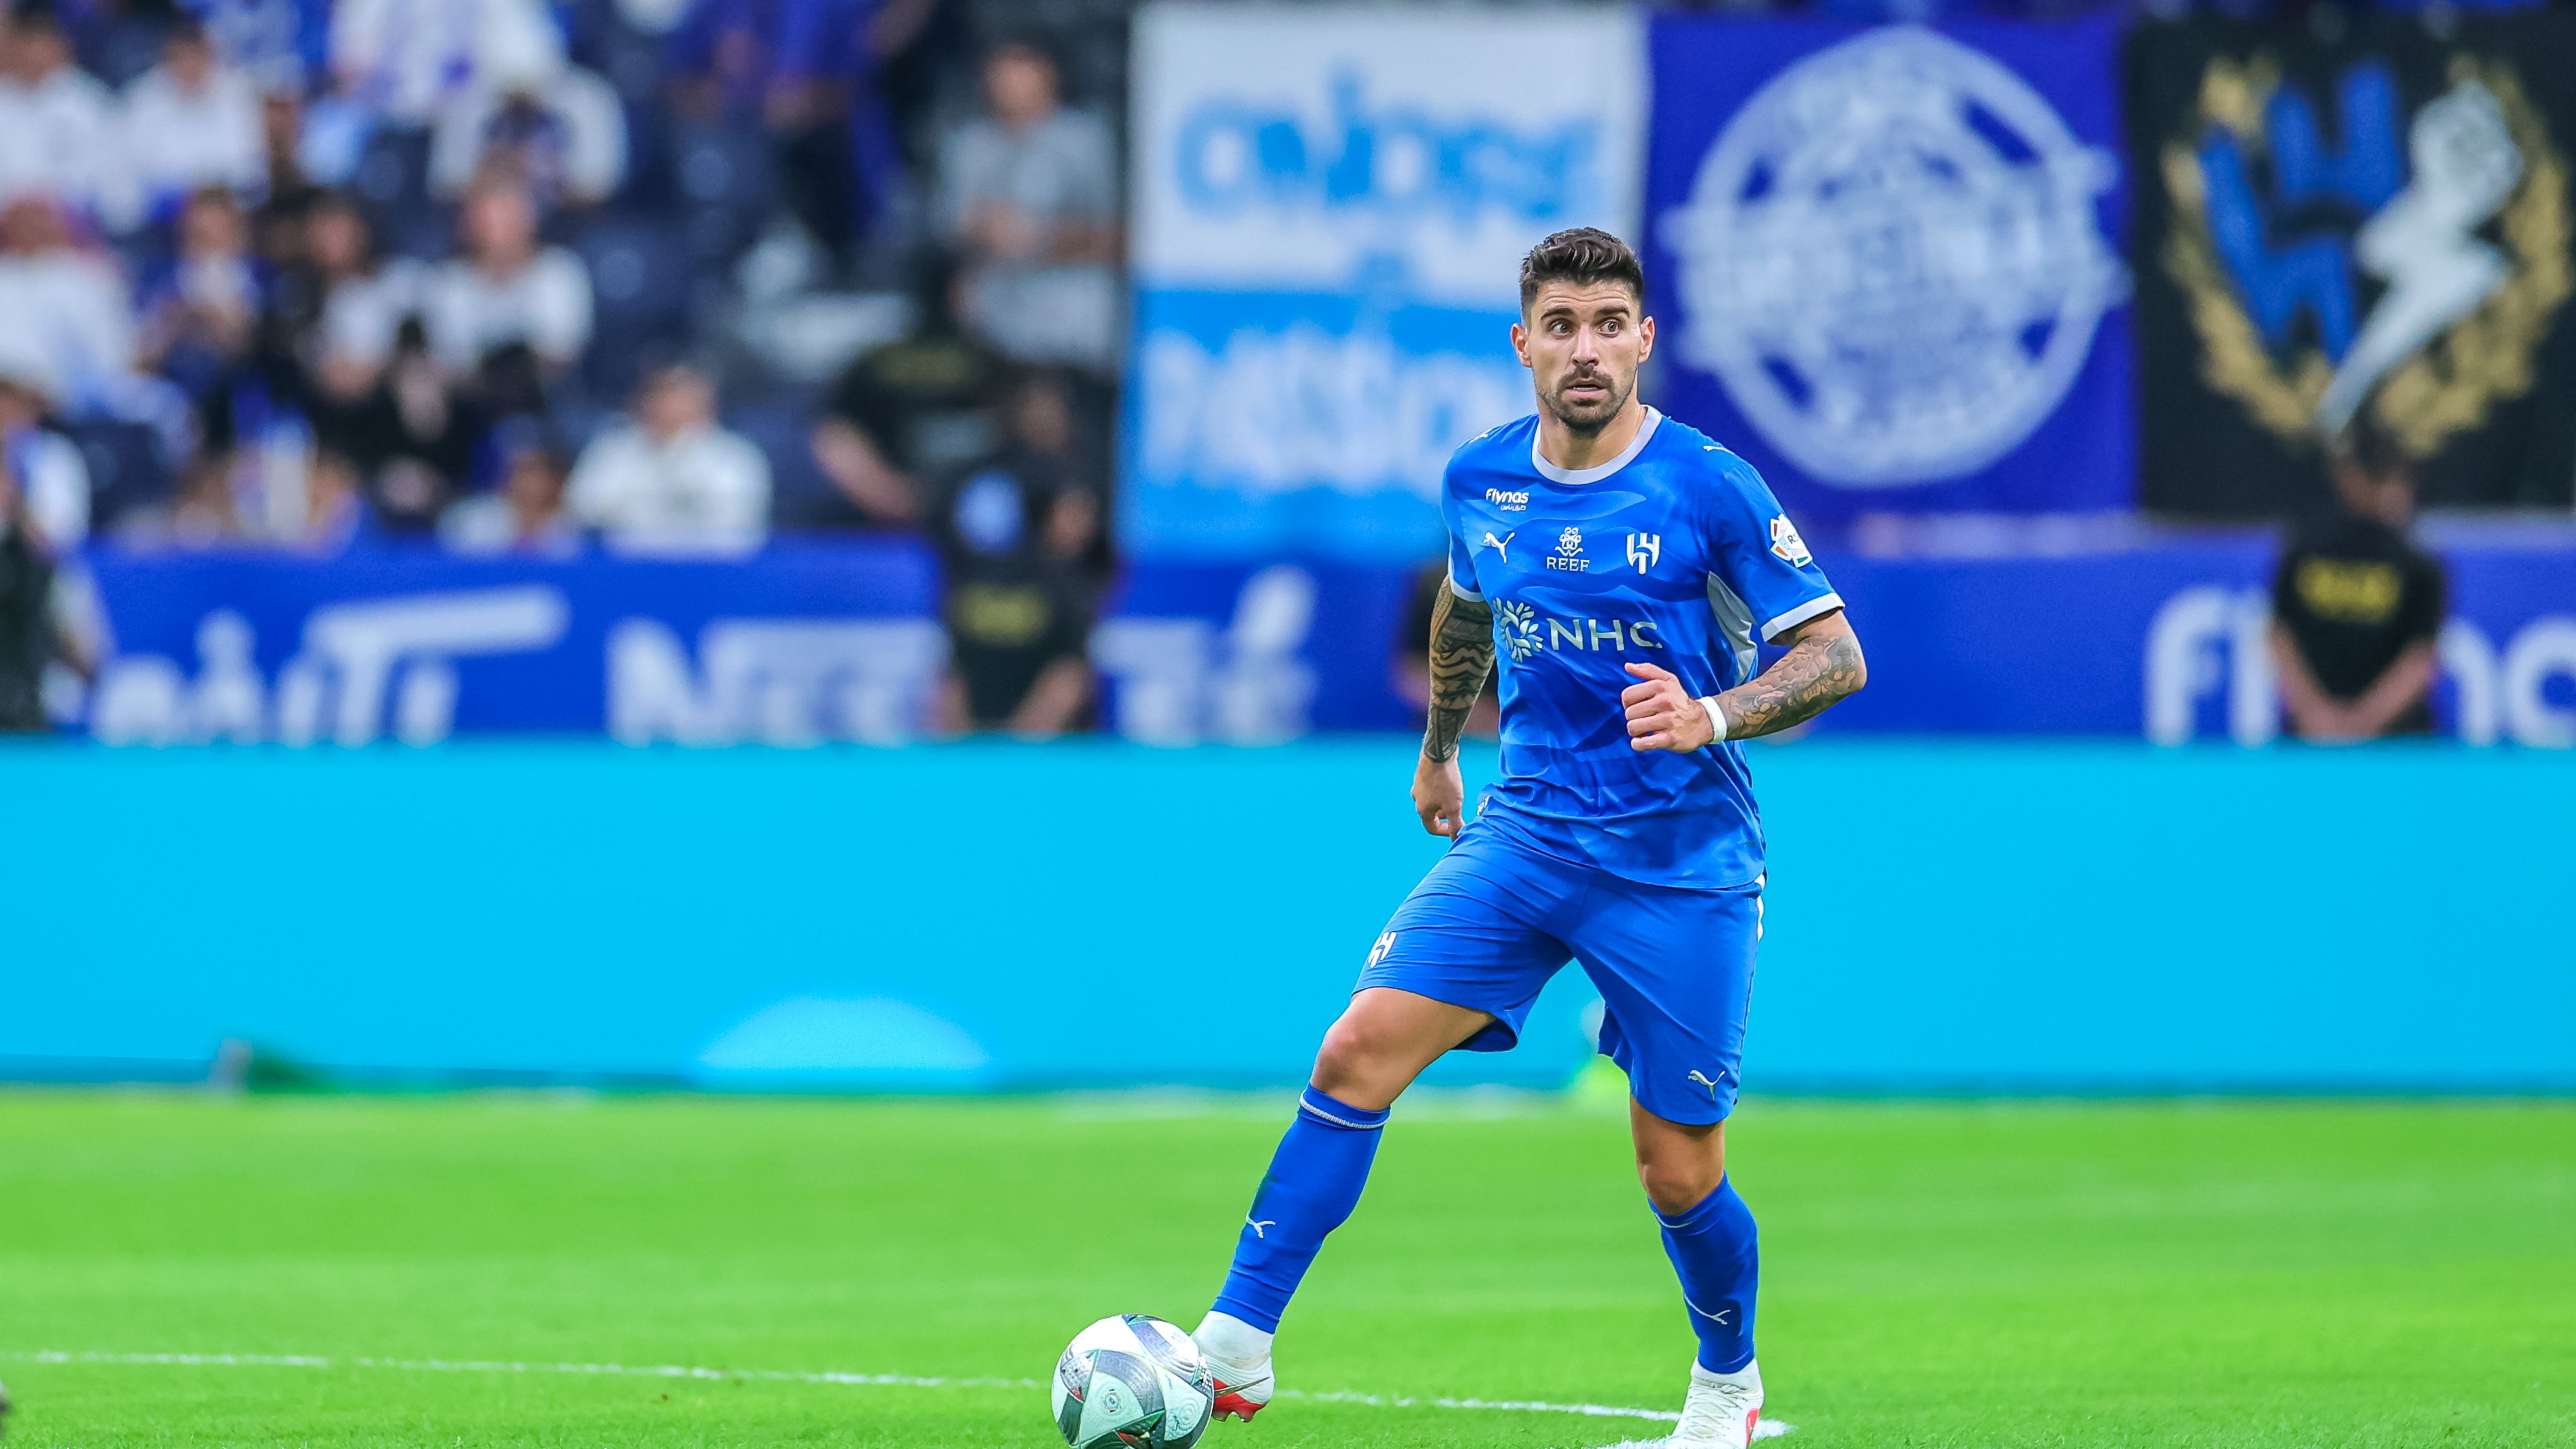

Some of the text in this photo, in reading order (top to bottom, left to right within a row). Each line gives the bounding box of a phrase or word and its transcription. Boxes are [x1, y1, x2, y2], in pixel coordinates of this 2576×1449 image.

[1486, 488, 1530, 505] flynas
[1546, 556, 1590, 572] REEF
[1546, 618, 1662, 651] NHC
